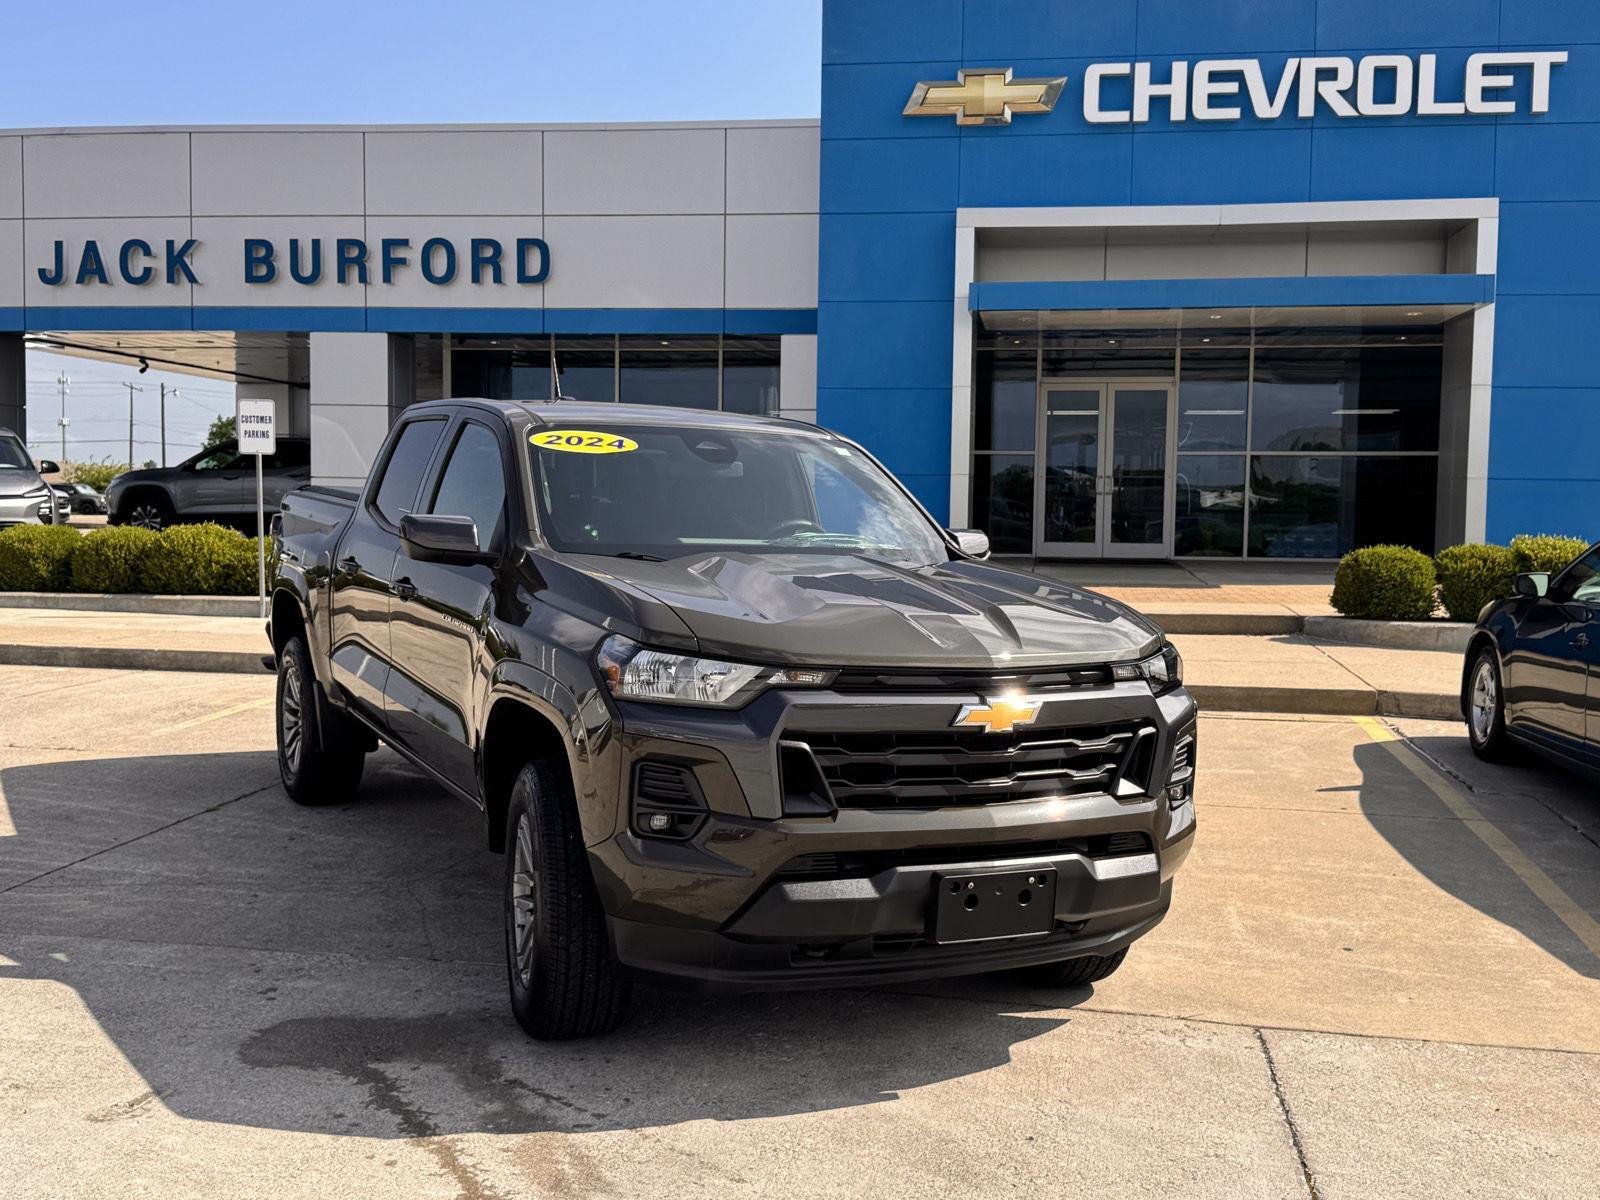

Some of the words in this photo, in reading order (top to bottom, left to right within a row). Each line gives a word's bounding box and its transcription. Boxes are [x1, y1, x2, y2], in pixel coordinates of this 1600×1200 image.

[1082, 51, 1568, 124] CHEVROLET
[37, 238, 201, 286] JACK
[244, 237, 550, 286] BURFORD
[241, 414, 272, 424] CUSTOMER
[244, 430, 270, 439] PARKING
[543, 434, 626, 449] 2024
